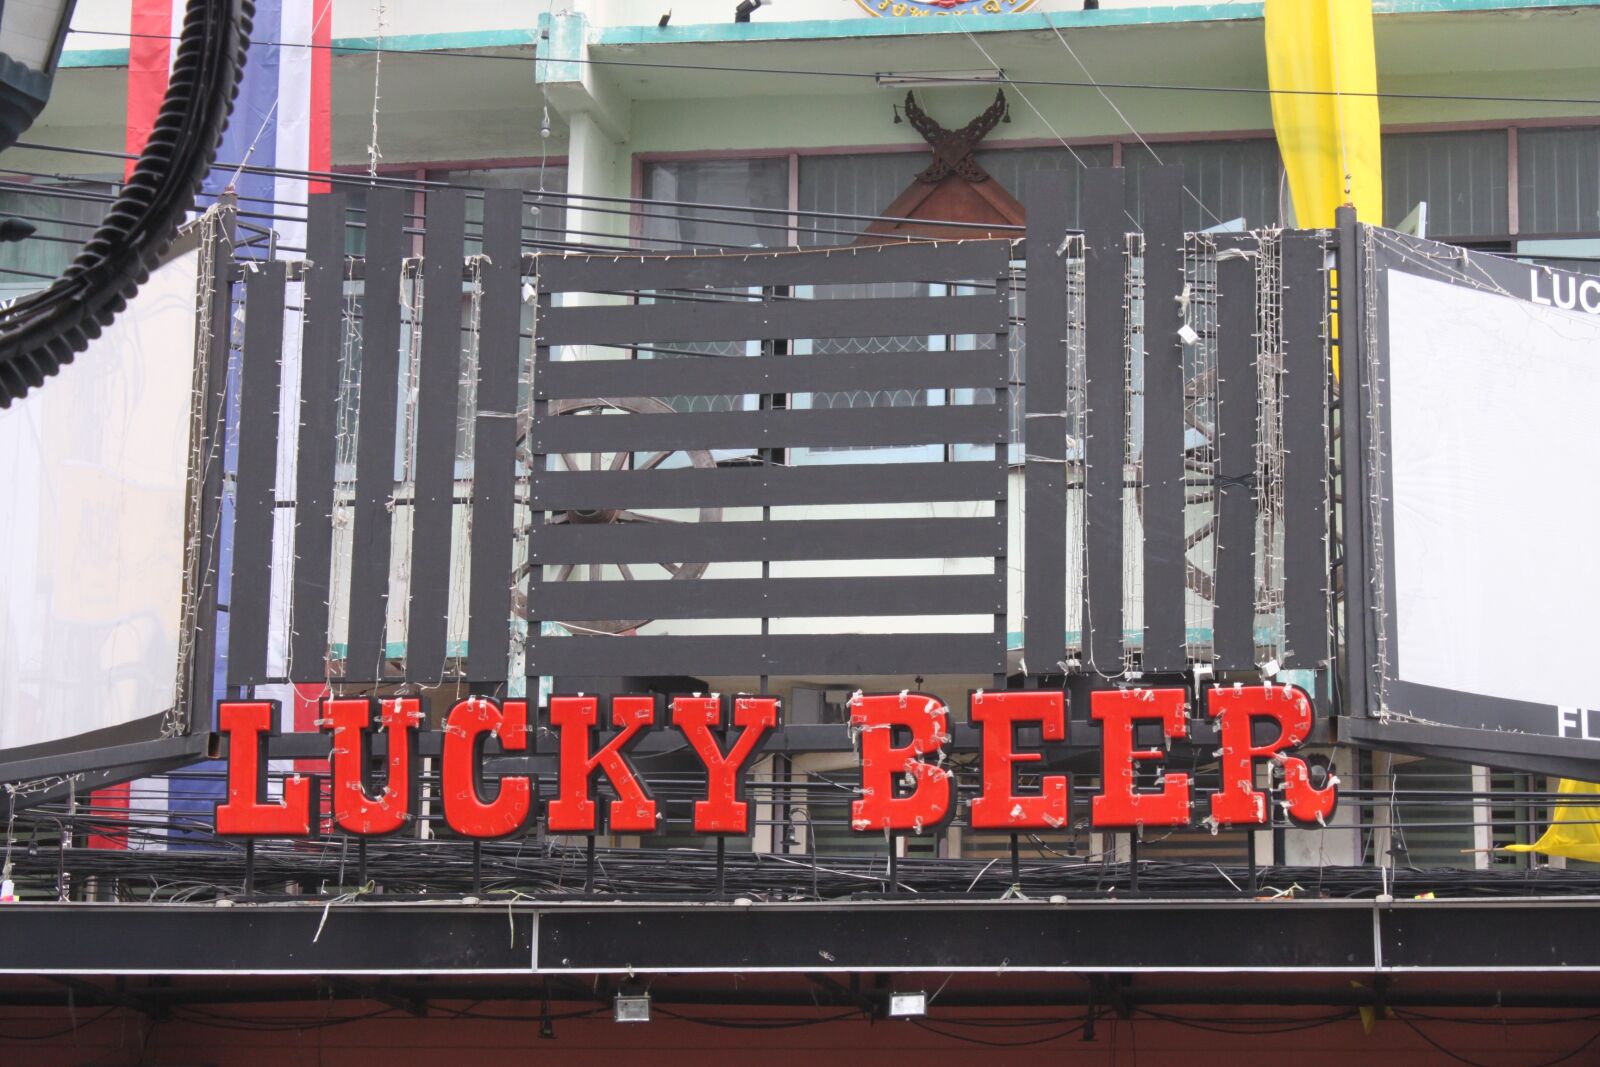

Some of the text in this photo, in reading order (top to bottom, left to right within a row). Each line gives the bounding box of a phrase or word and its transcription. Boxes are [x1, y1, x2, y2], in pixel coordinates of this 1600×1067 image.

[1530, 268, 1600, 315] LUC
[214, 683, 1340, 838] LUCKY BEER
